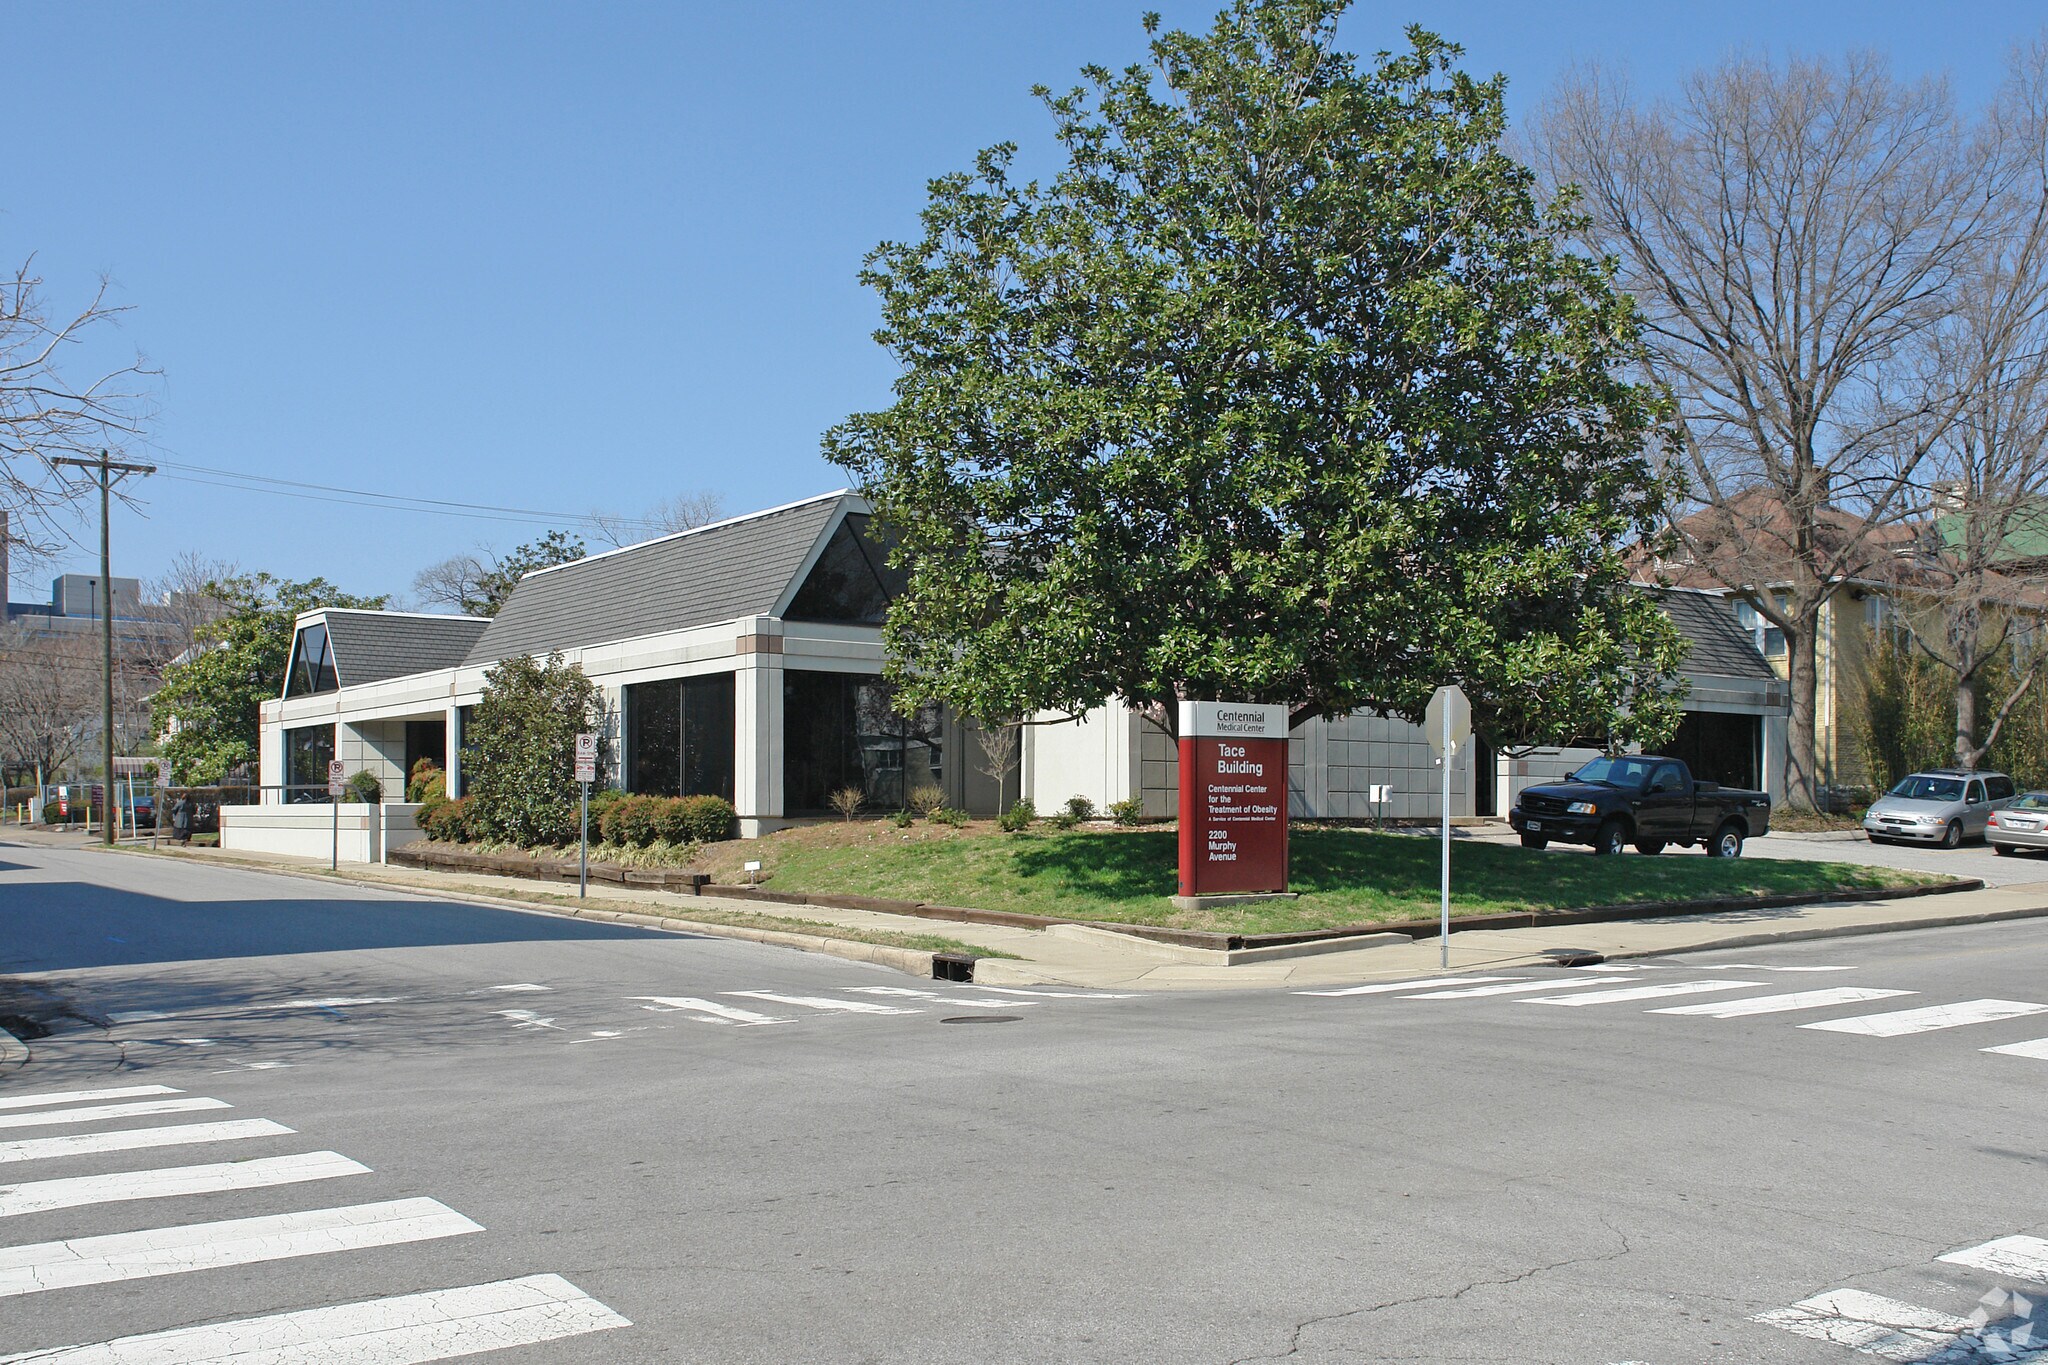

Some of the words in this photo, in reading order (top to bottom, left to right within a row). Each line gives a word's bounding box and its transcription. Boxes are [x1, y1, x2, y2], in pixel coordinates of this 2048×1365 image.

[1217, 710, 1265, 722] Centennial
[1217, 723, 1243, 732] Medical
[1243, 724, 1265, 733] Center
[1218, 744, 1246, 757] Tace
[1218, 760, 1263, 777] Building
[1208, 784, 1244, 793] Centennial
[1244, 784, 1268, 793] Center
[1208, 795, 1218, 803] for
[1220, 795, 1231, 803] the
[1208, 805, 1242, 814] Treatment
[1243, 805, 1251, 813] of
[1252, 805, 1278, 815] Obesity
[1208, 830, 1228, 840] 2200
[1208, 841, 1237, 852] Murphy
[1209, 852, 1237, 861] Avenue
